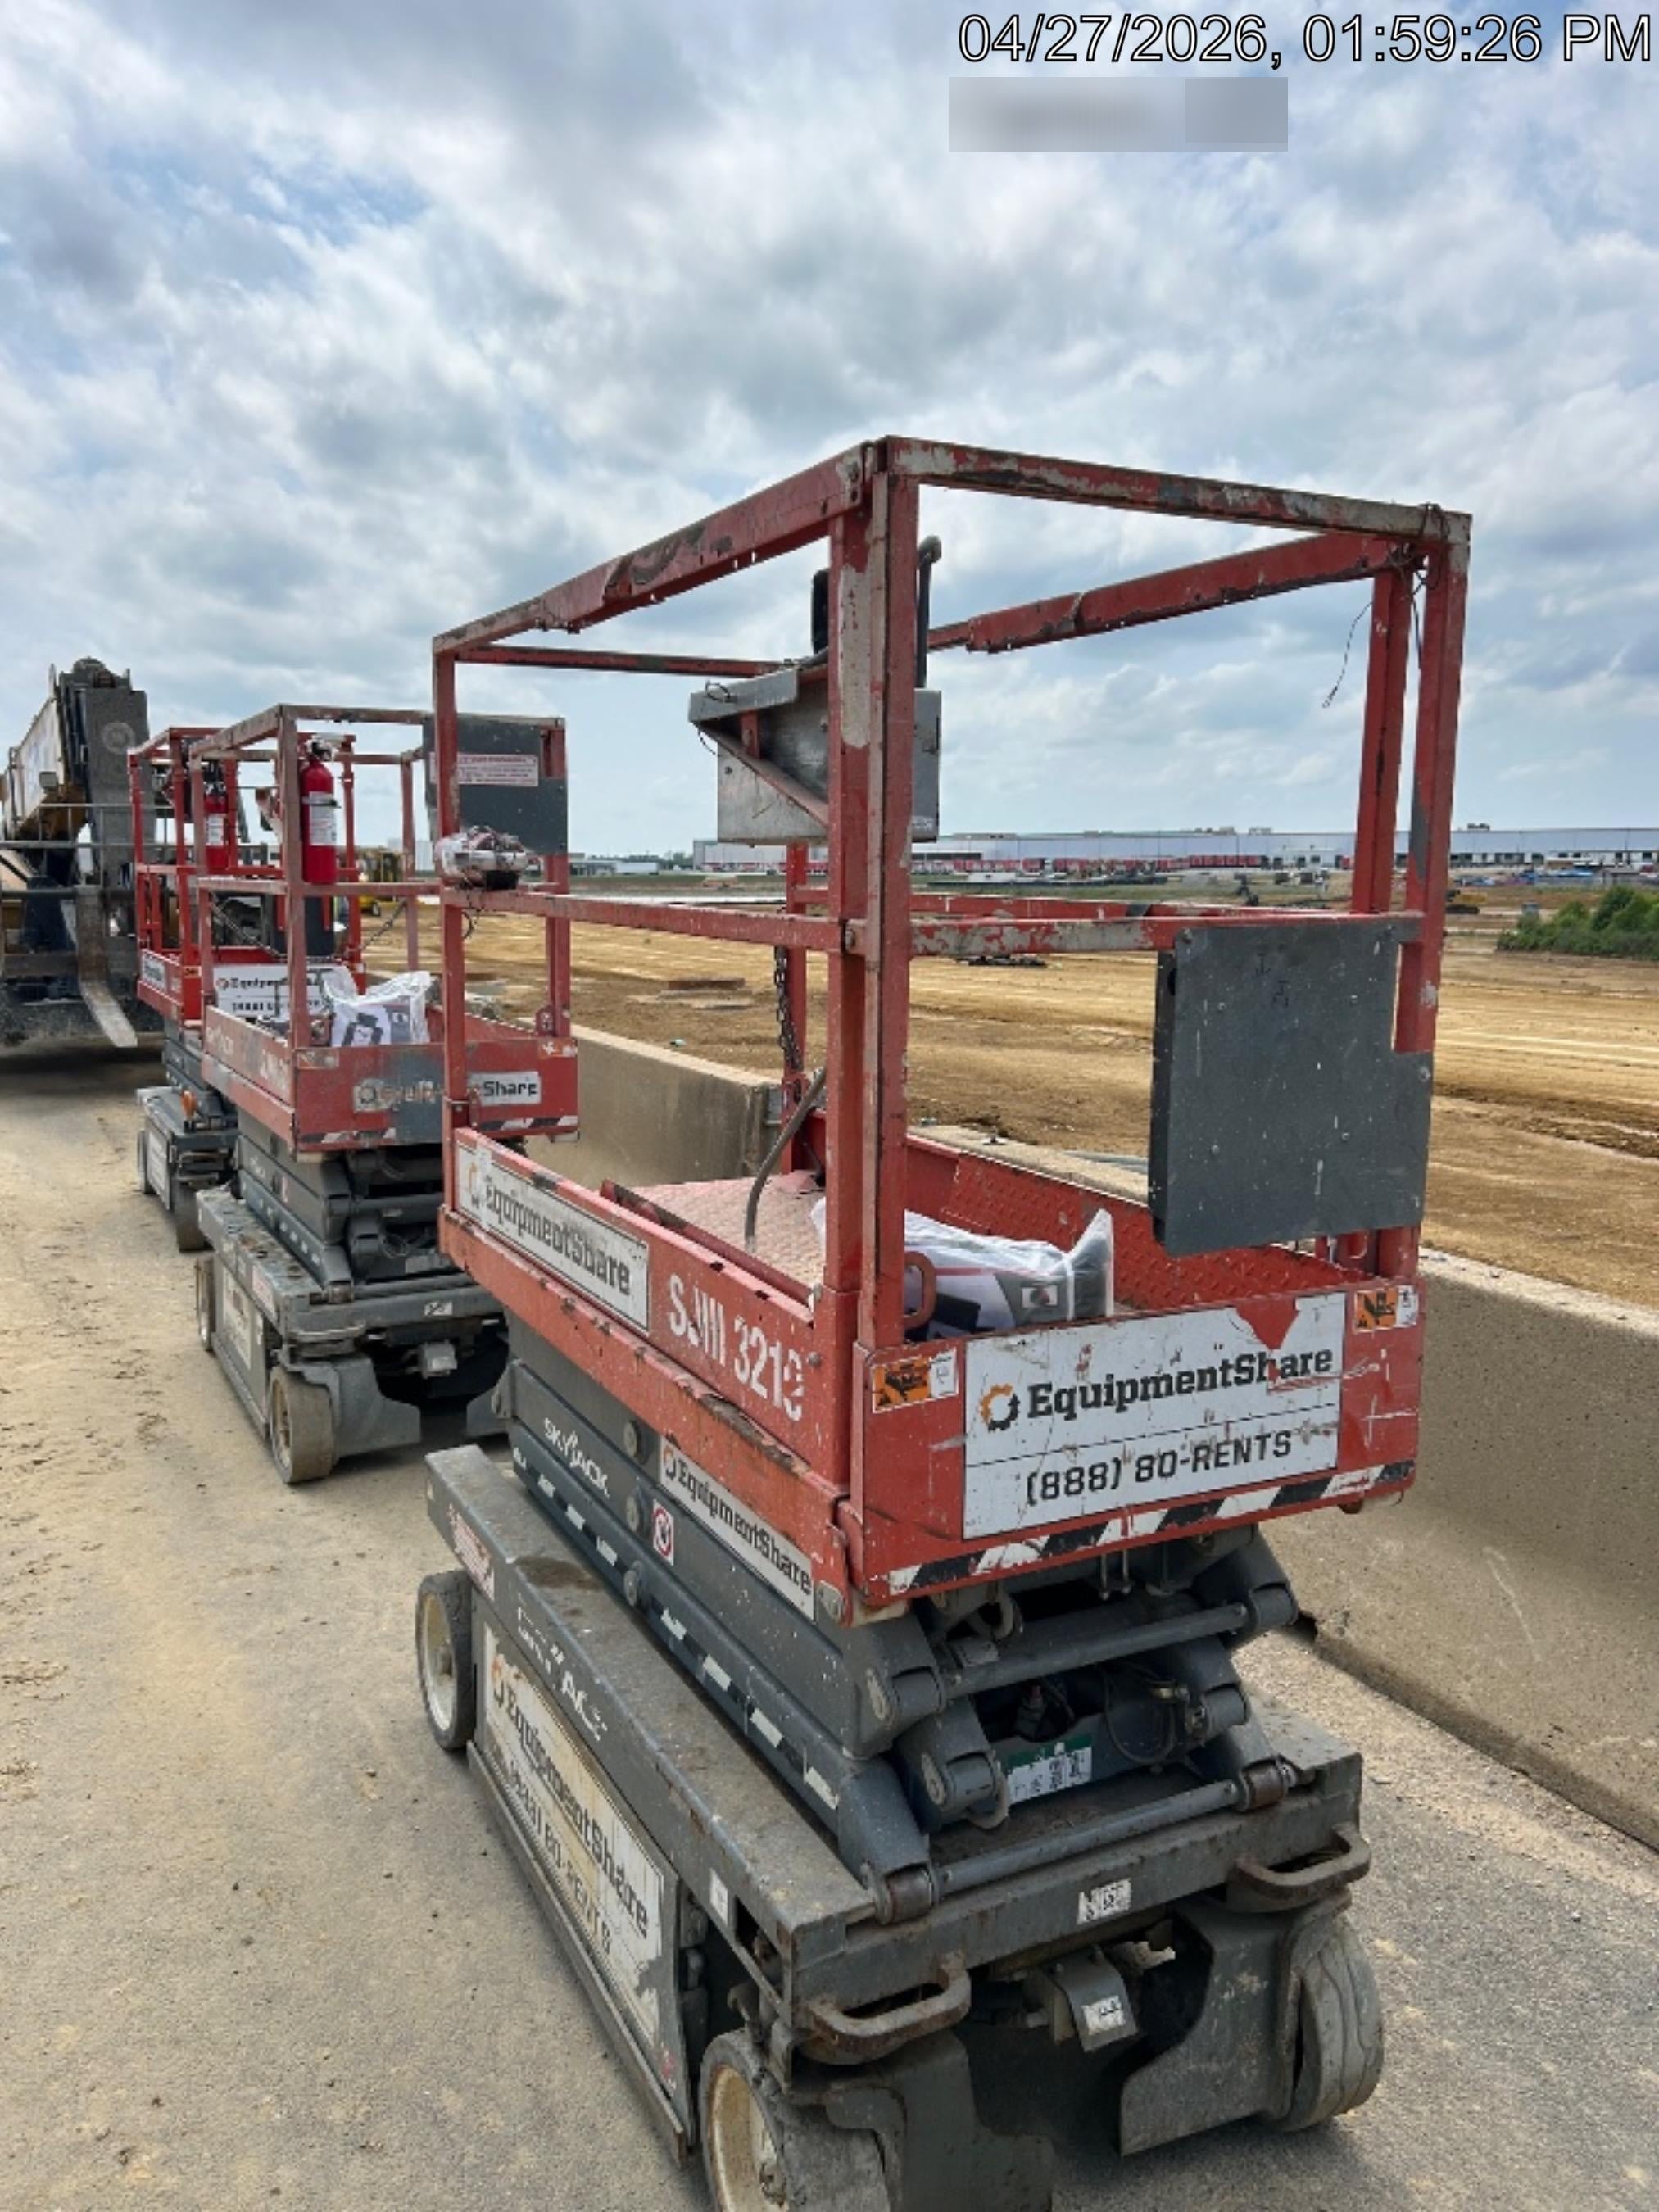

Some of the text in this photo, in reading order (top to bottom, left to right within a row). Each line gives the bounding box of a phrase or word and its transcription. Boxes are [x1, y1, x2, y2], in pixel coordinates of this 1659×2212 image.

[1027, 1349, 1333, 1421] EquipmentShare
[1027, 1430, 1292, 1507] (888) 80-RENTS
[678, 1458, 812, 1596] EquipmentShare
